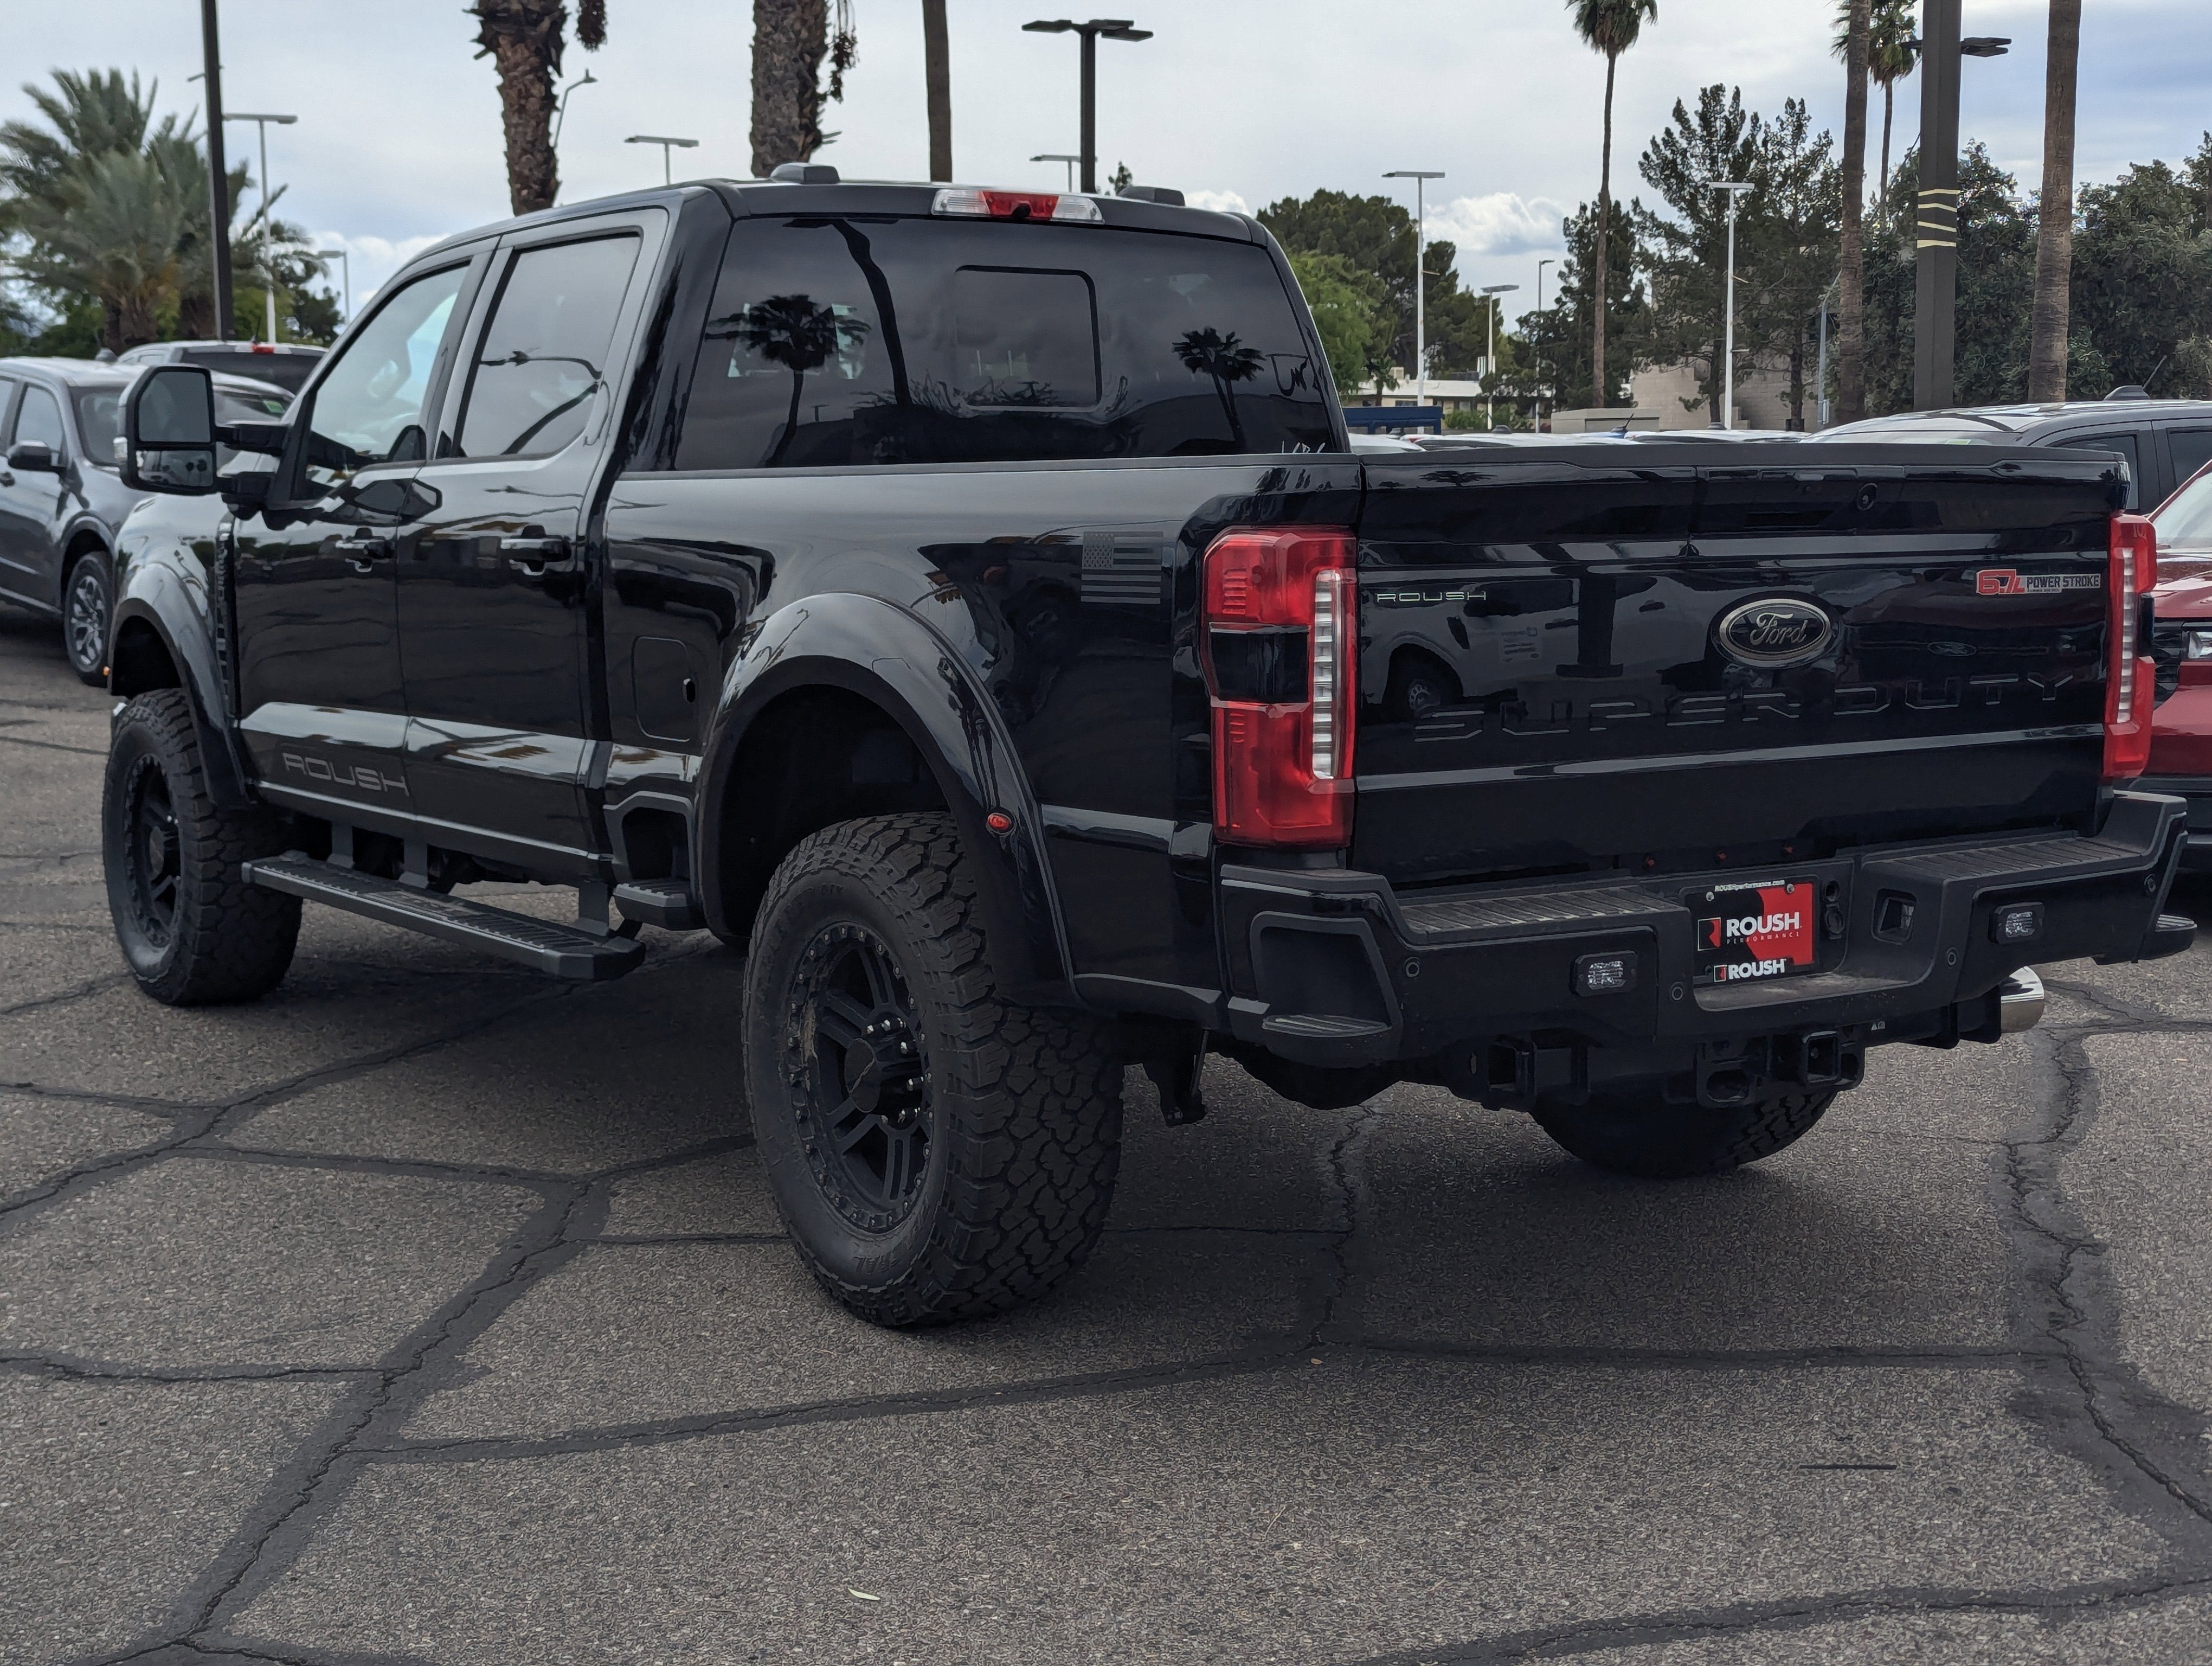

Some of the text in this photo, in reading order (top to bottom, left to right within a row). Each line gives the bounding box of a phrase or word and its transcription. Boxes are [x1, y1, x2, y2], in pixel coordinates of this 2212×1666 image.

[2027, 576, 2061, 588] POWER
[2062, 575, 2100, 588] STROKE
[1377, 591, 1487, 603] ROUSH
[1750, 612, 1808, 645] Ford
[1413, 672, 2074, 742] SUPER DUTY
[282, 752, 410, 797] ROUSH
[1726, 912, 1800, 938] ROUSH
[1726, 932, 1799, 945] PERFORMANCE
[1728, 959, 1785, 979] ROUSH
